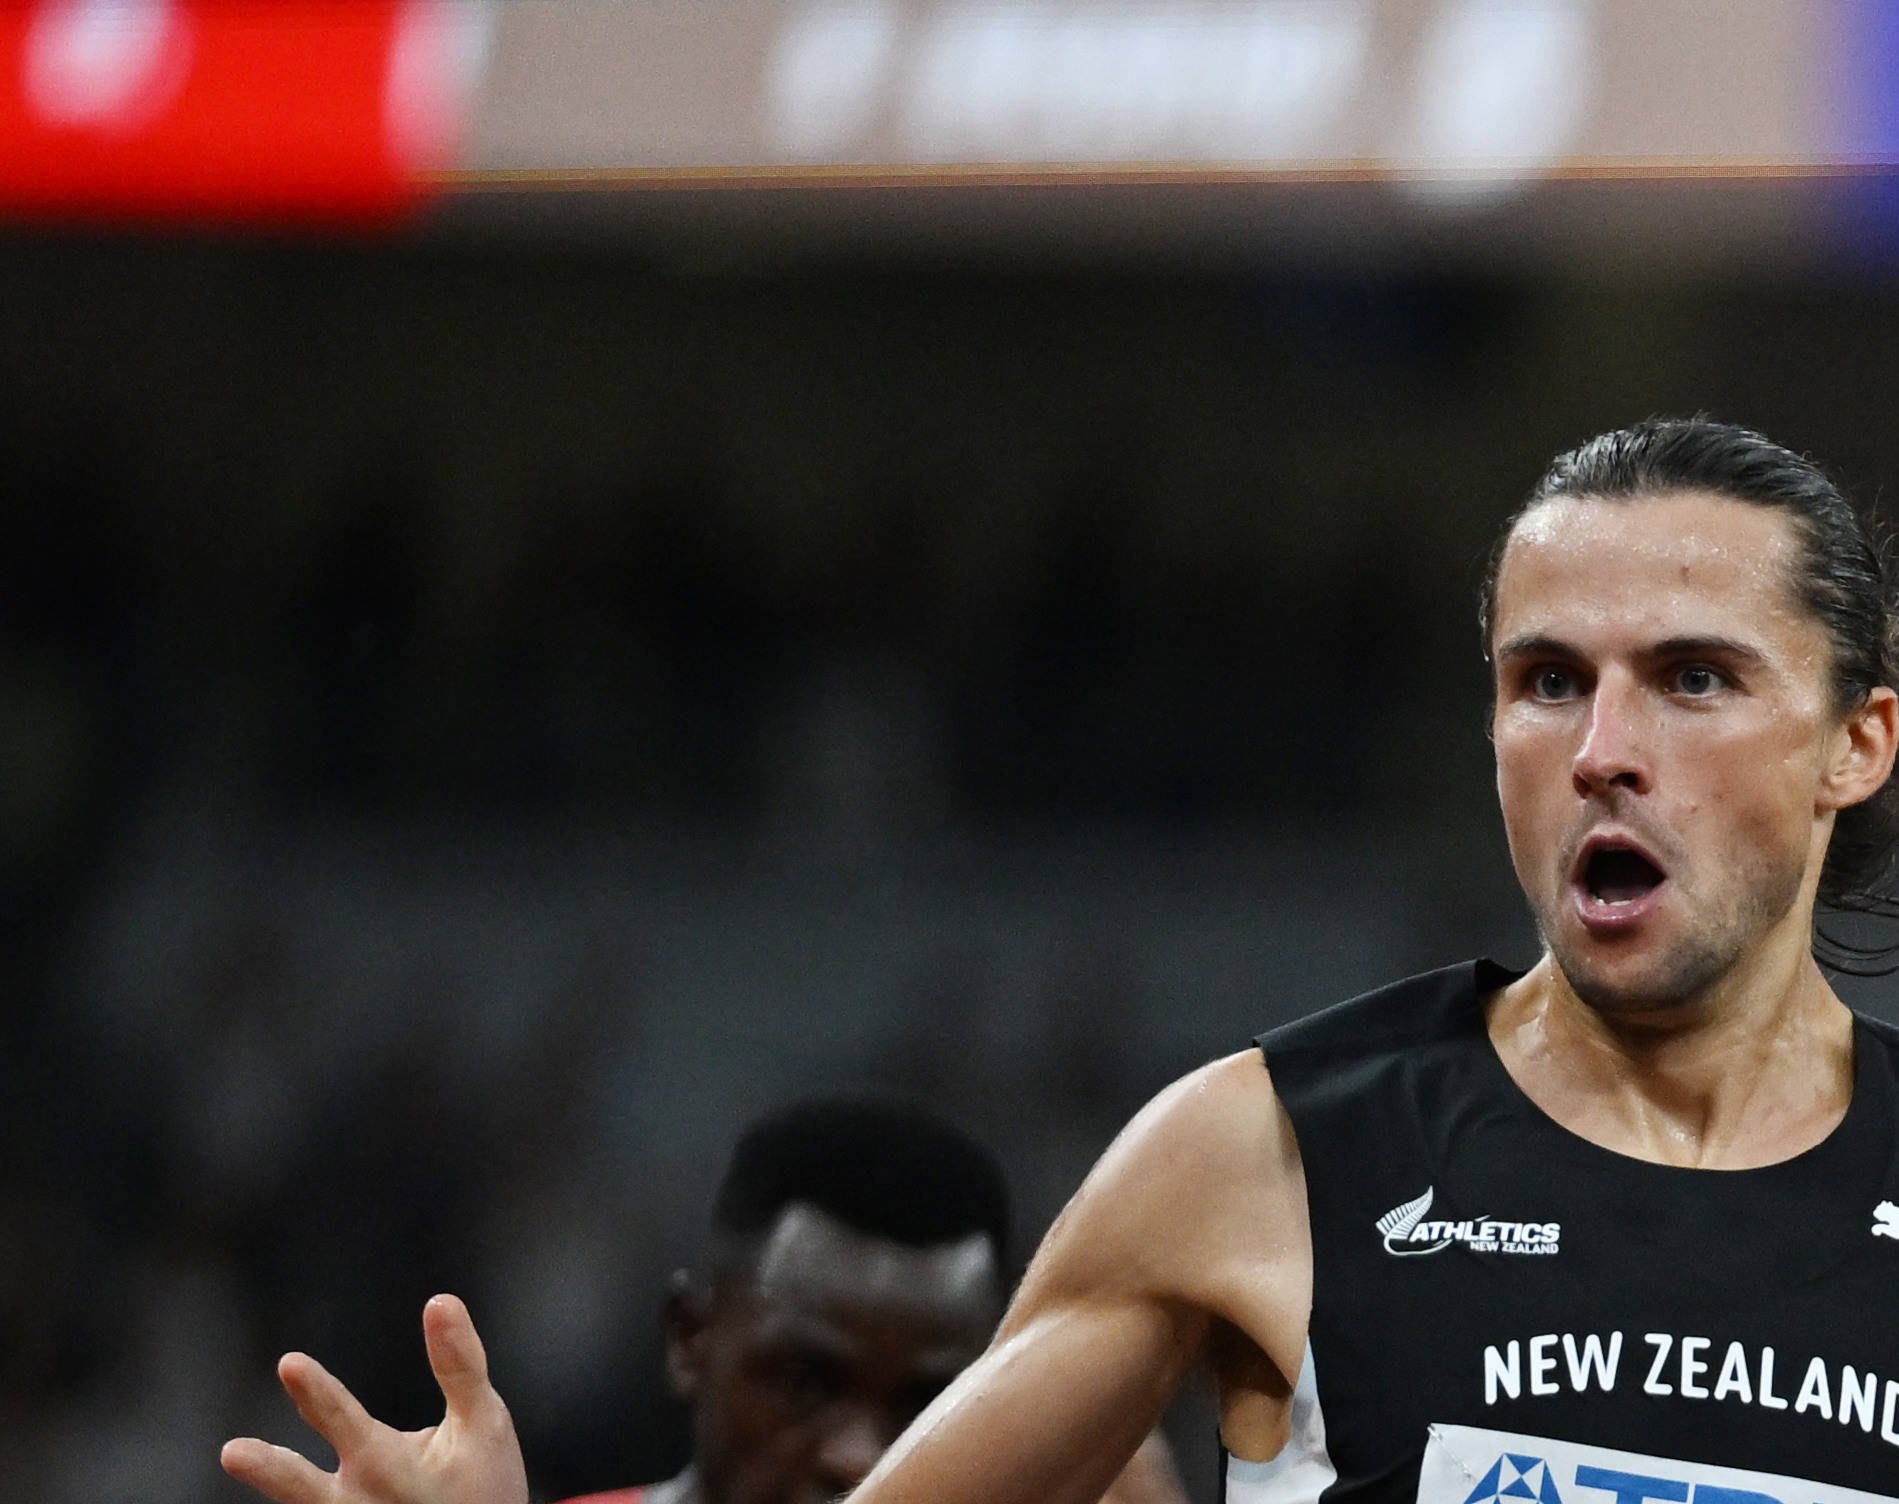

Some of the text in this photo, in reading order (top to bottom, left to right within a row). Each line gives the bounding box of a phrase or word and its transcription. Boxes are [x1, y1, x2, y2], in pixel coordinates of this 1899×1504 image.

[1409, 1220, 1562, 1244] ATHLETICS
[1470, 1241, 1560, 1255] NEW ZEALAND
[1483, 1330, 1623, 1406] NEW
